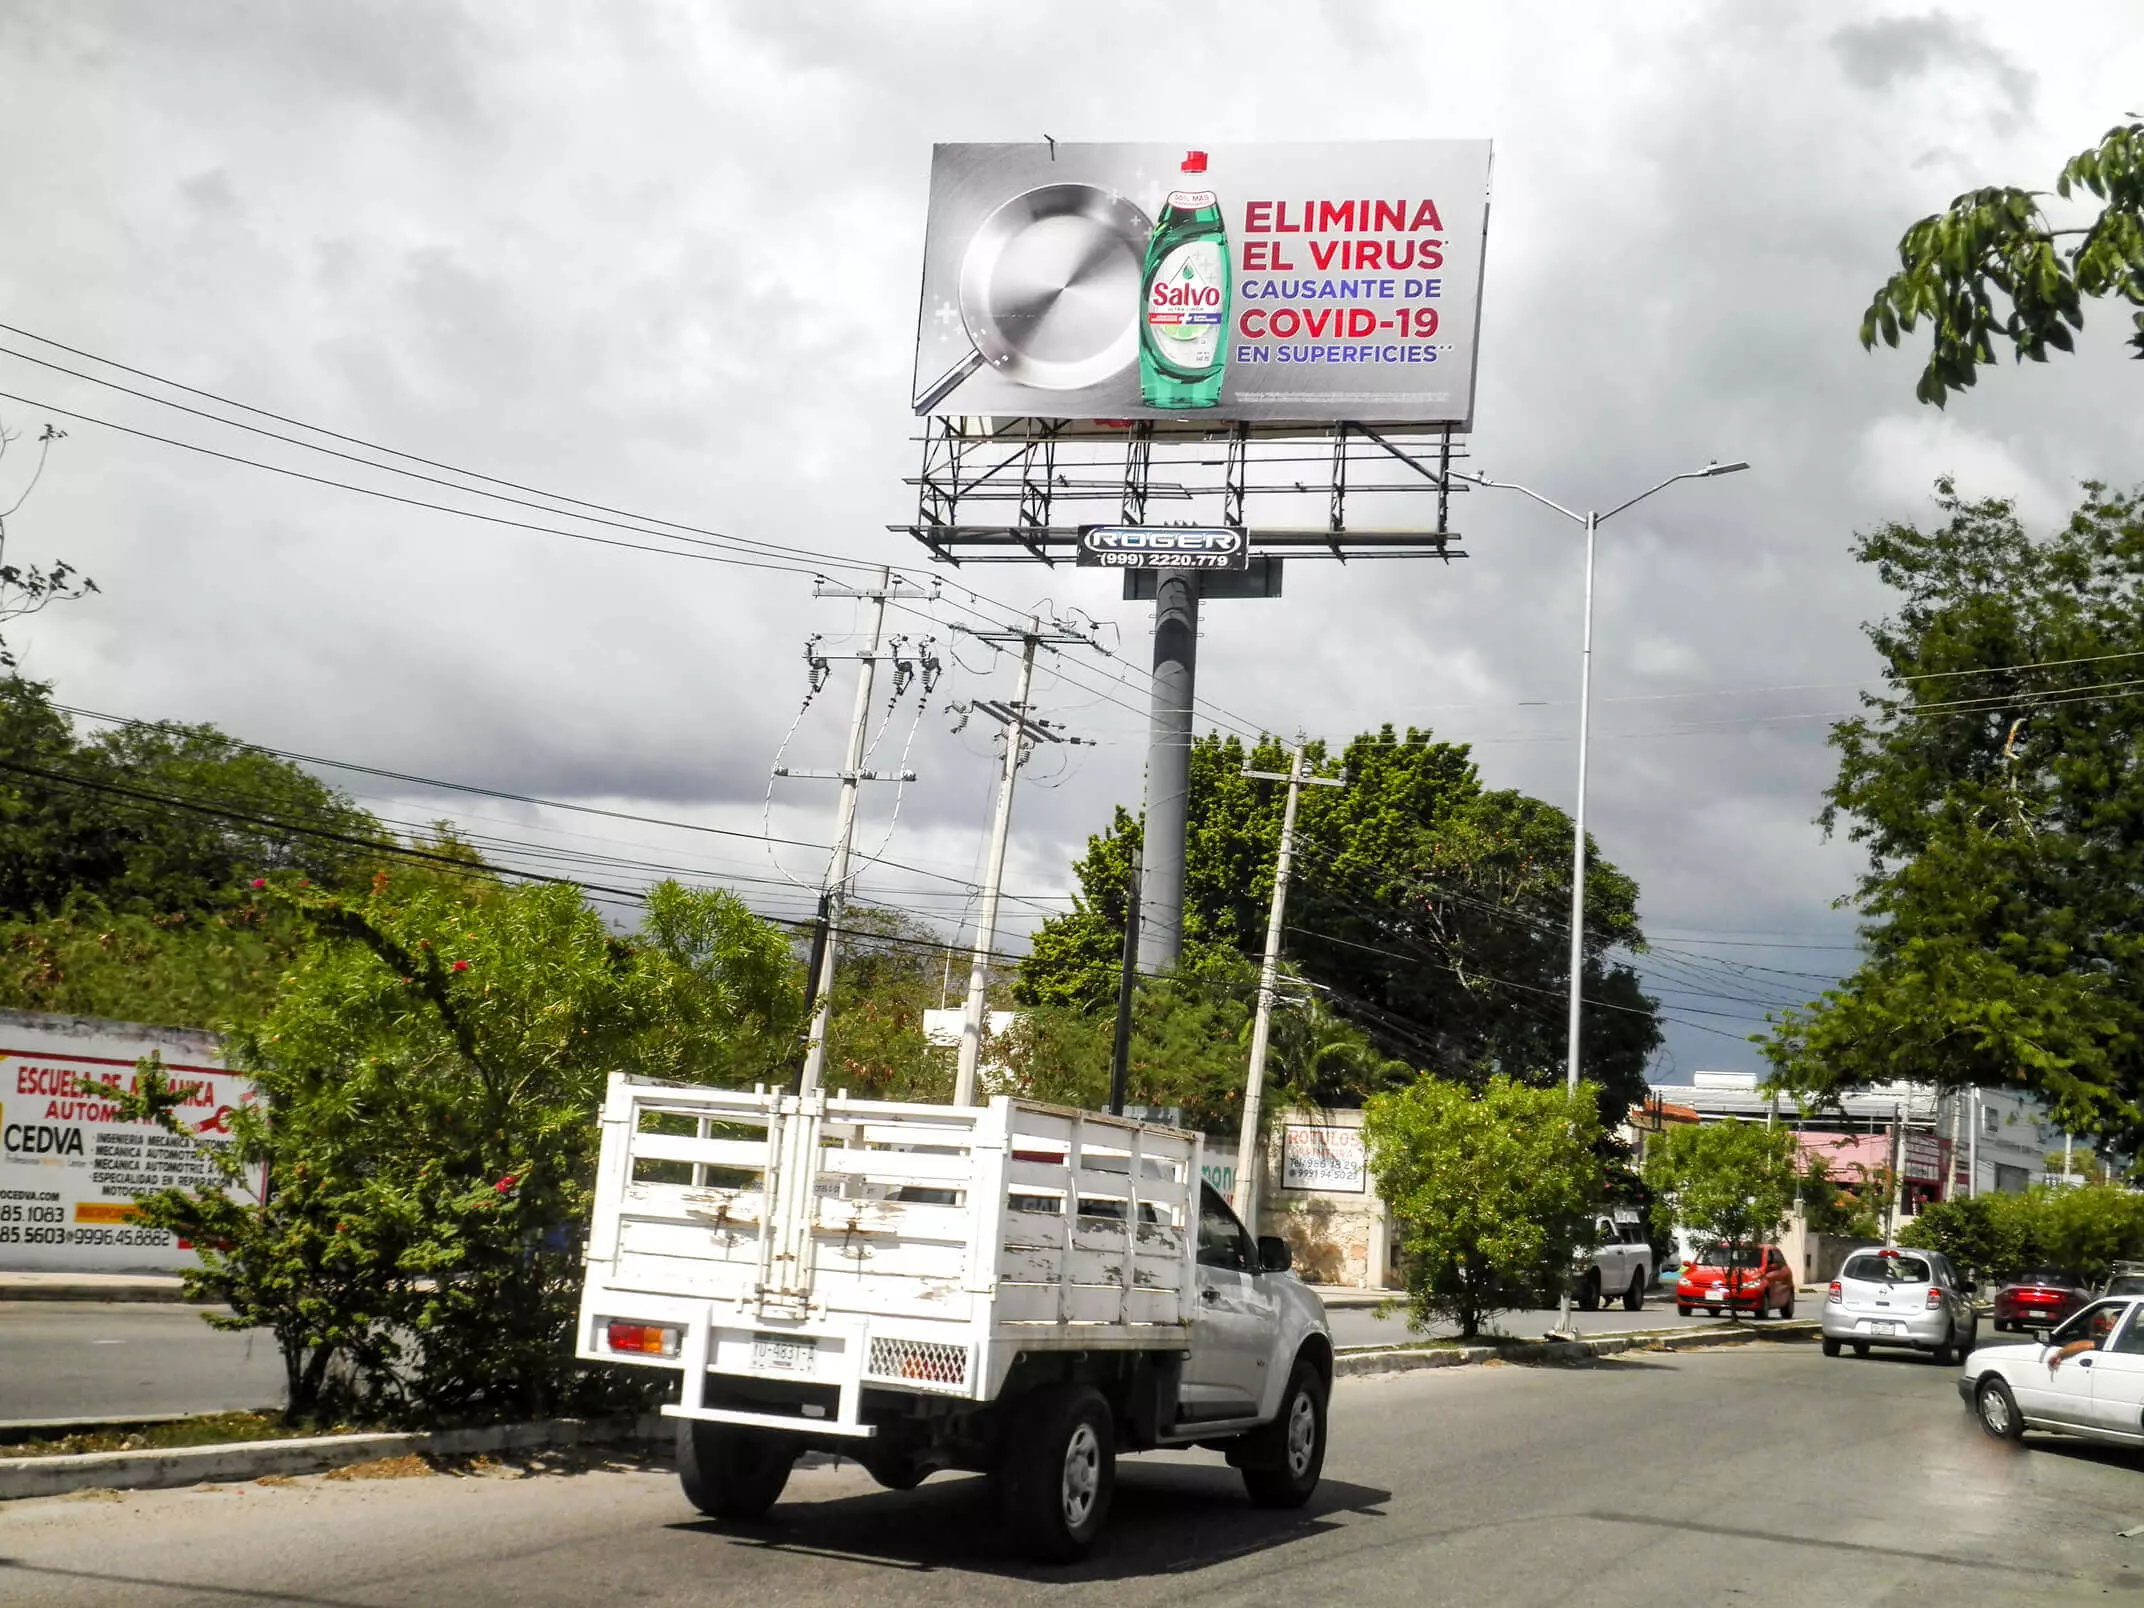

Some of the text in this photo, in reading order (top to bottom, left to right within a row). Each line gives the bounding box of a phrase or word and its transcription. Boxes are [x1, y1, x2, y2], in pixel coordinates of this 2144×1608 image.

[1244, 199, 1444, 233] ELIMINA
[1242, 240, 1294, 271] EL
[1152, 282, 1220, 307] Salvo
[1241, 278, 1442, 299] CAUSANTE DE
[1239, 307, 1440, 339] COVID-19
[1236, 345, 1269, 363] EN
[1092, 532, 1235, 549] ROGER
[1100, 553, 1229, 568] (999) 2220.779
[16, 1066, 92, 1099] ESCUELA
[4, 1123, 84, 1156] CEDVA
